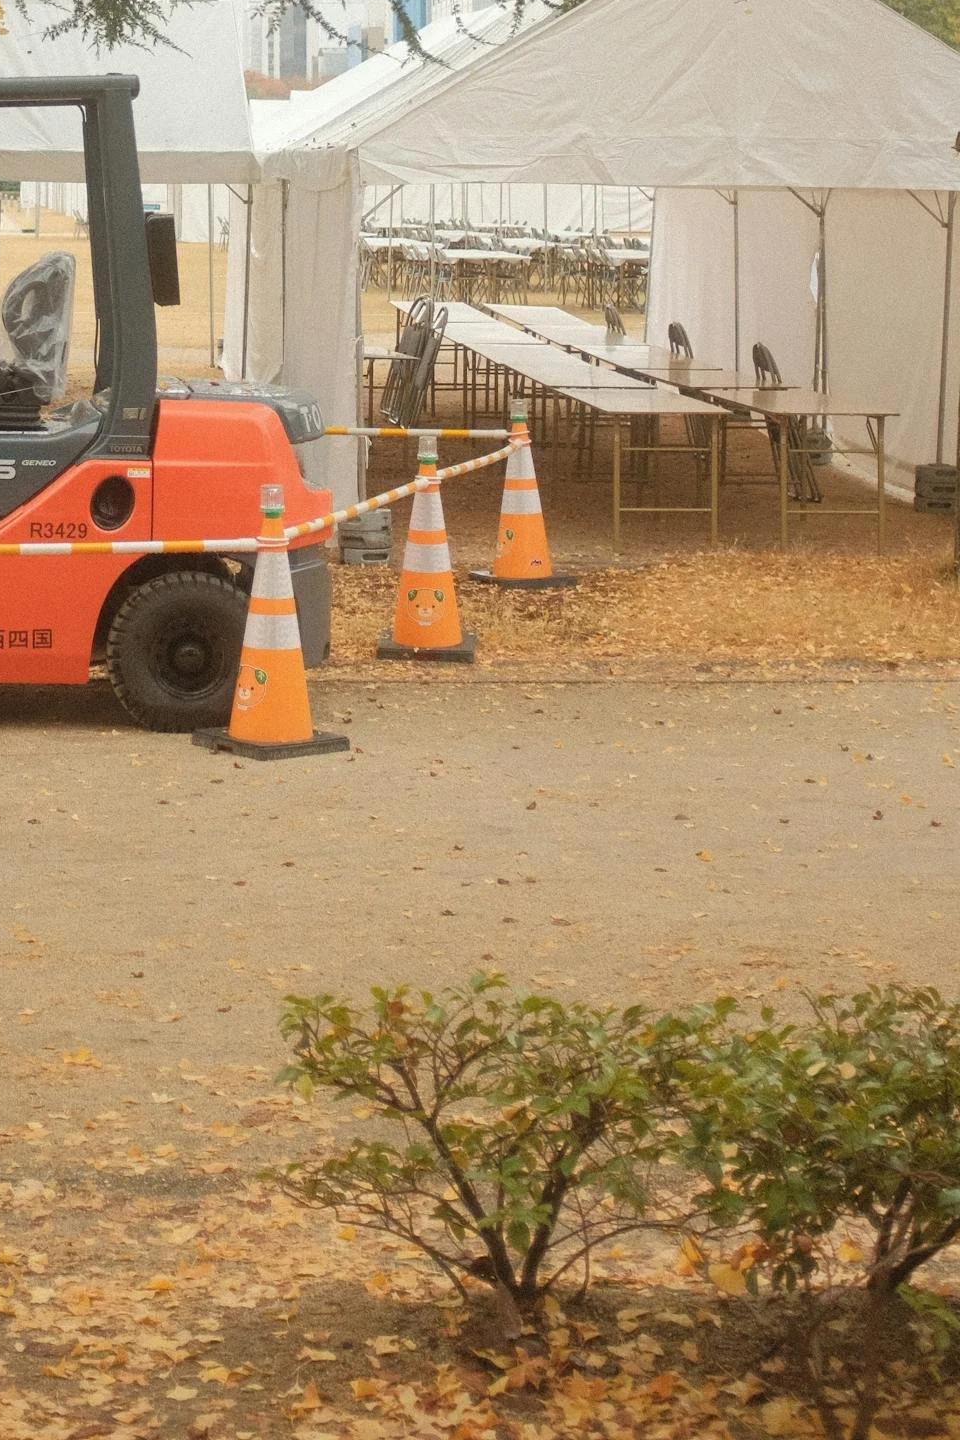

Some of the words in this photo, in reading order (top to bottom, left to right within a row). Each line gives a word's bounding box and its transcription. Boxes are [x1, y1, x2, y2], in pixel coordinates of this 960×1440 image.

[109, 445, 143, 453] TOYOTA
[21, 459, 57, 467] GENEO
[30, 522, 88, 539] R3429
